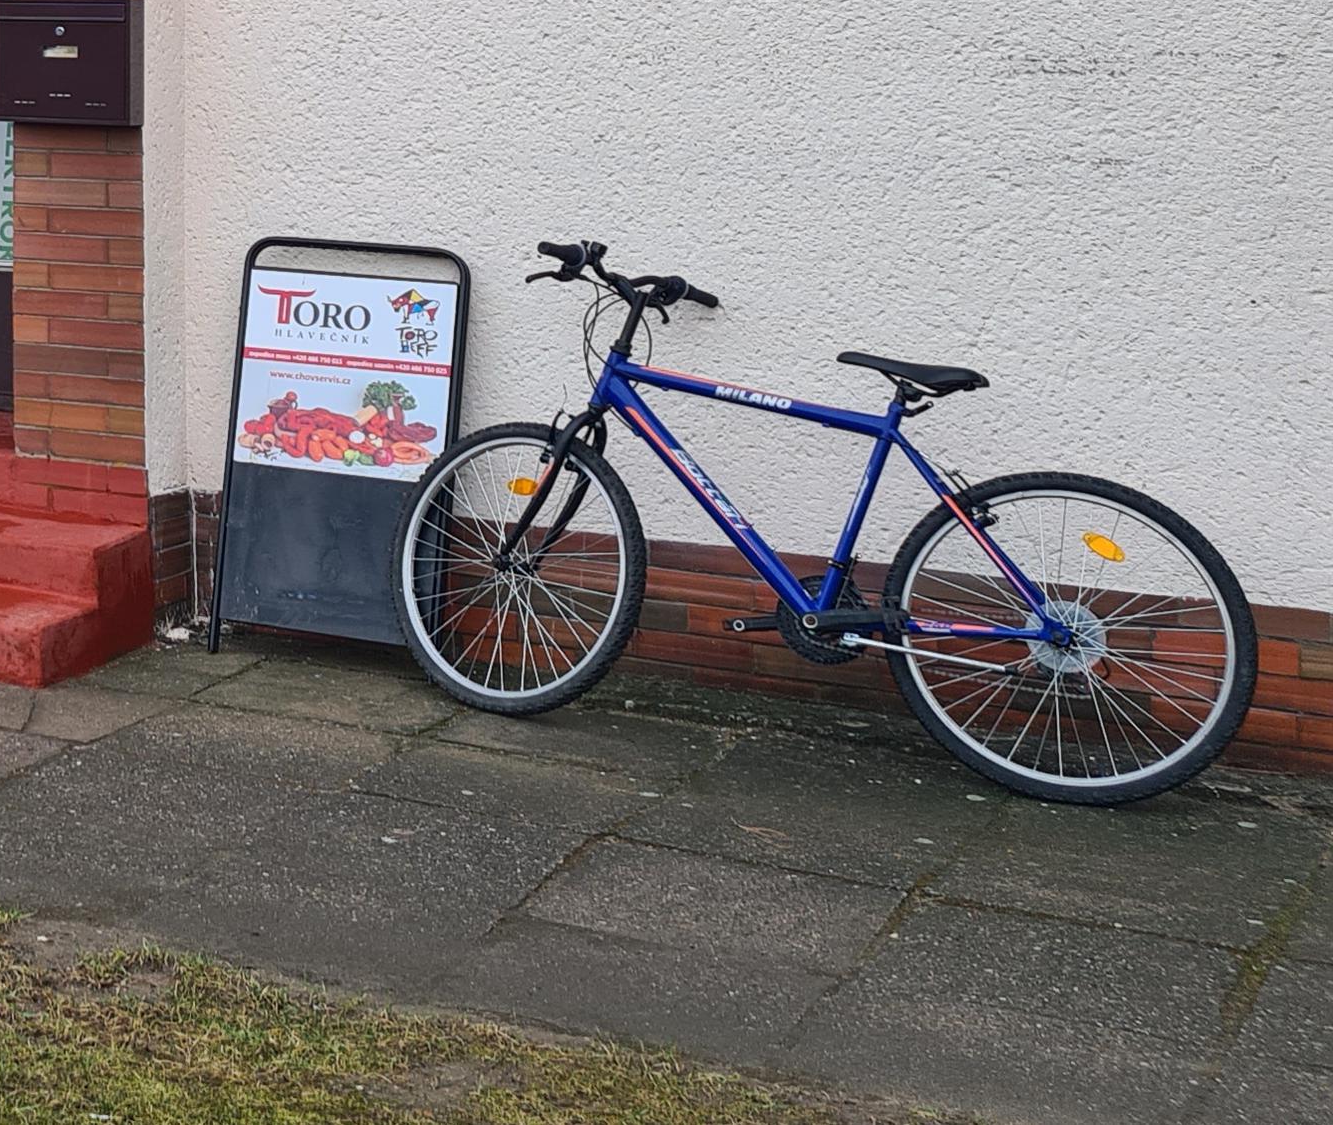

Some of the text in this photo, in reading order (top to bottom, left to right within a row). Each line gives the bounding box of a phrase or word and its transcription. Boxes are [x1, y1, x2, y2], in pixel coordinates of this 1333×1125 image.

[257, 284, 372, 332] TORO
[274, 328, 370, 345] HLAVEČNÍK
[395, 326, 438, 343] TORO
[269, 369, 352, 385] www.chovservis.cz
[714, 385, 793, 410] MILANO
